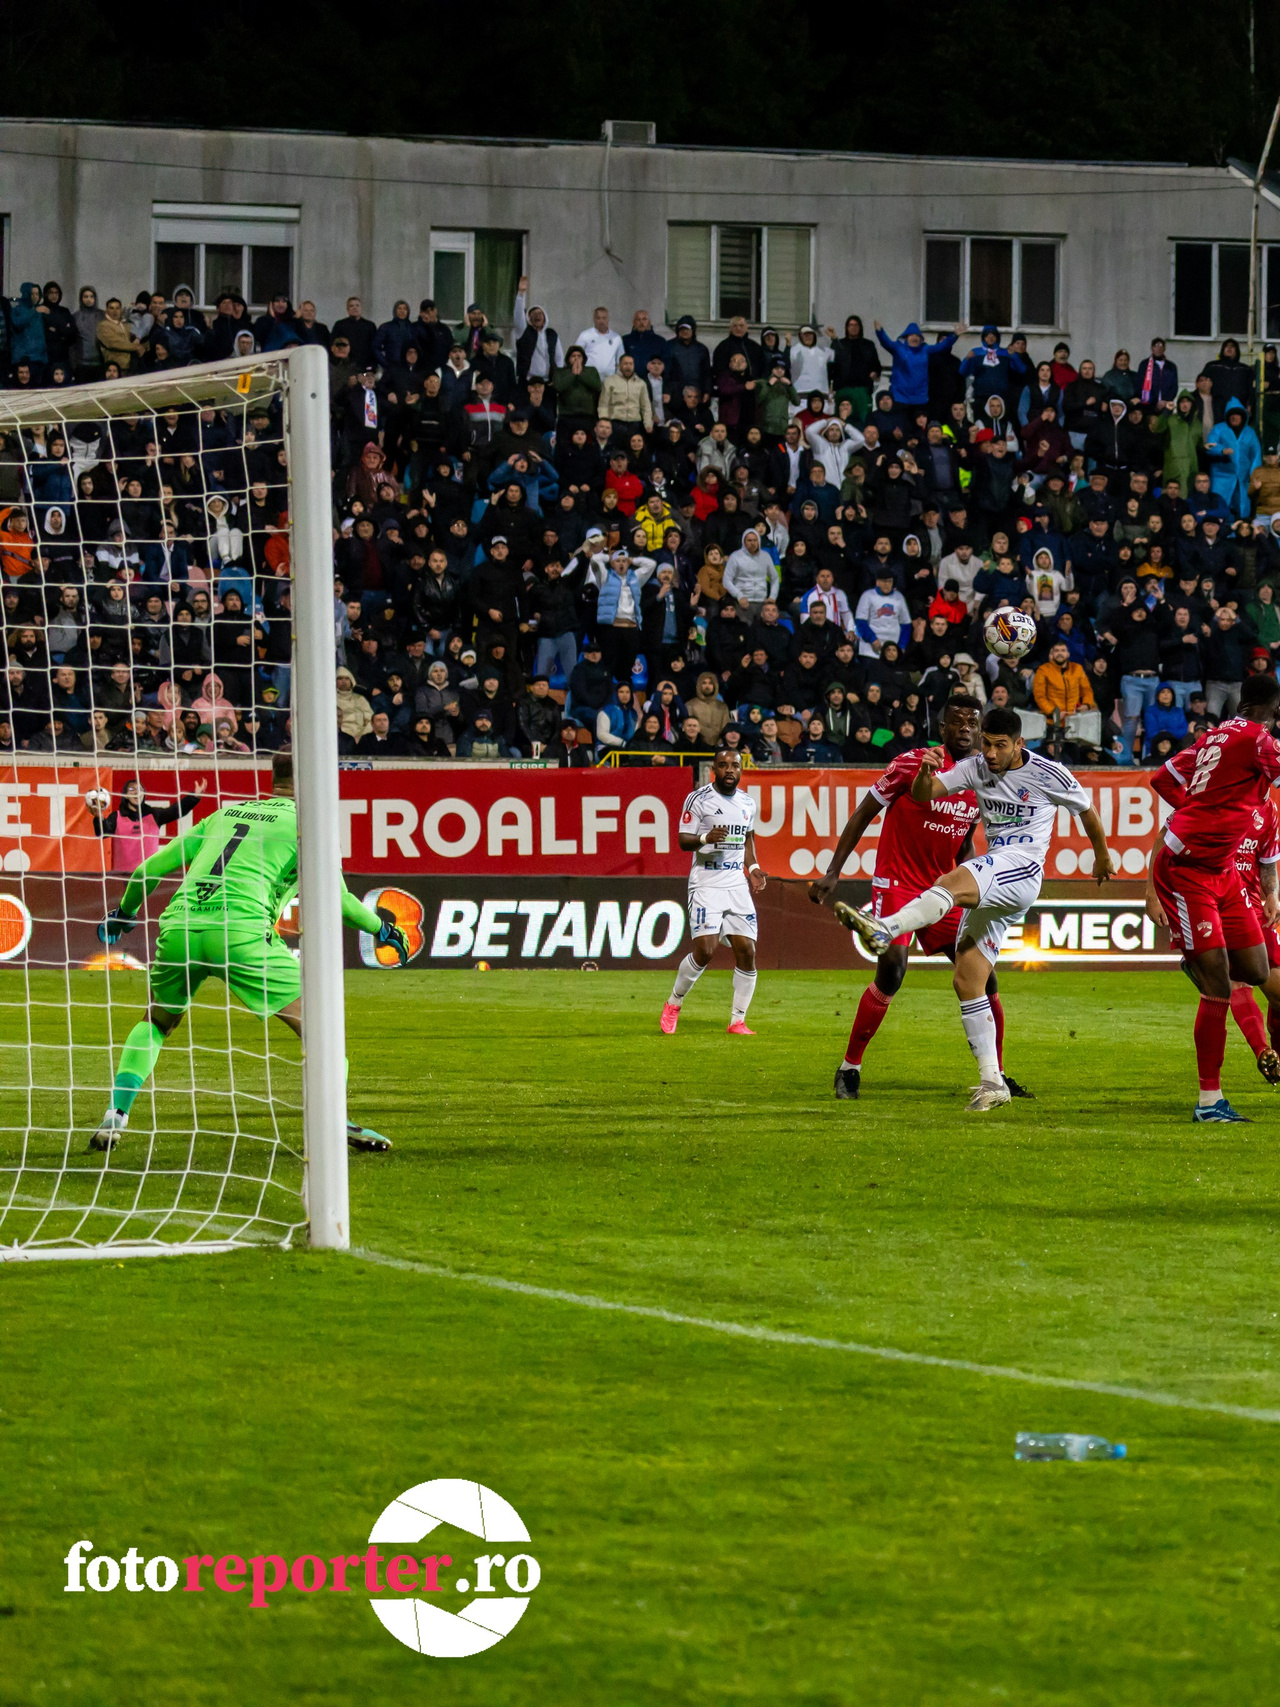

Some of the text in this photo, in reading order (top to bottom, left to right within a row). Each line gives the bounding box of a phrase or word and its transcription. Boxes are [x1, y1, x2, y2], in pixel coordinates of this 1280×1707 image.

[984, 799, 1038, 818] UNIBET
[210, 823, 250, 876] 1
[430, 899, 685, 960] BETANO
[1040, 913, 1156, 951] MECI
